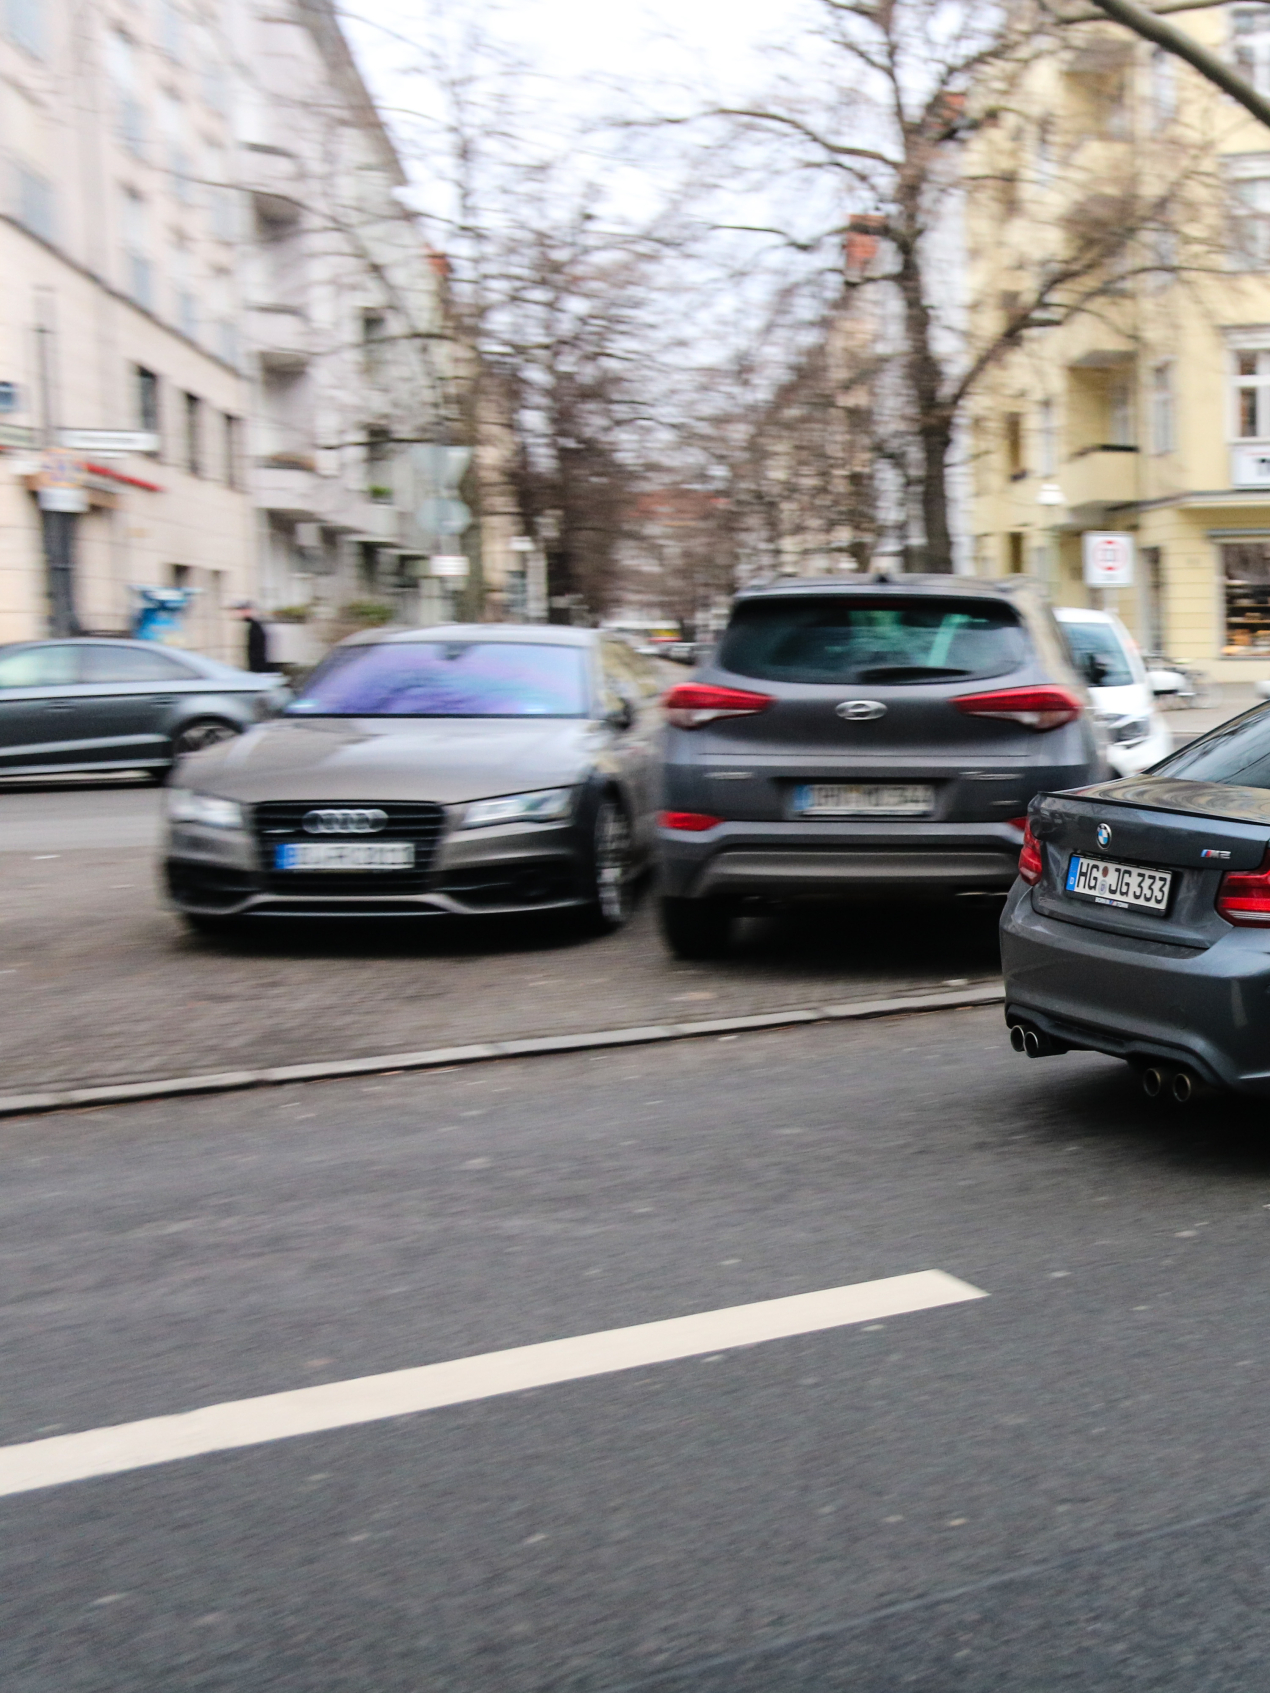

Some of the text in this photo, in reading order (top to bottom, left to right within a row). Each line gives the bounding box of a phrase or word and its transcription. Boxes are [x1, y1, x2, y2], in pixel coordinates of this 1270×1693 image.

[1201, 849, 1231, 859] M2
[1076, 861, 1100, 891] HG
[1108, 868, 1132, 897] JG
[1133, 873, 1167, 904] 333
